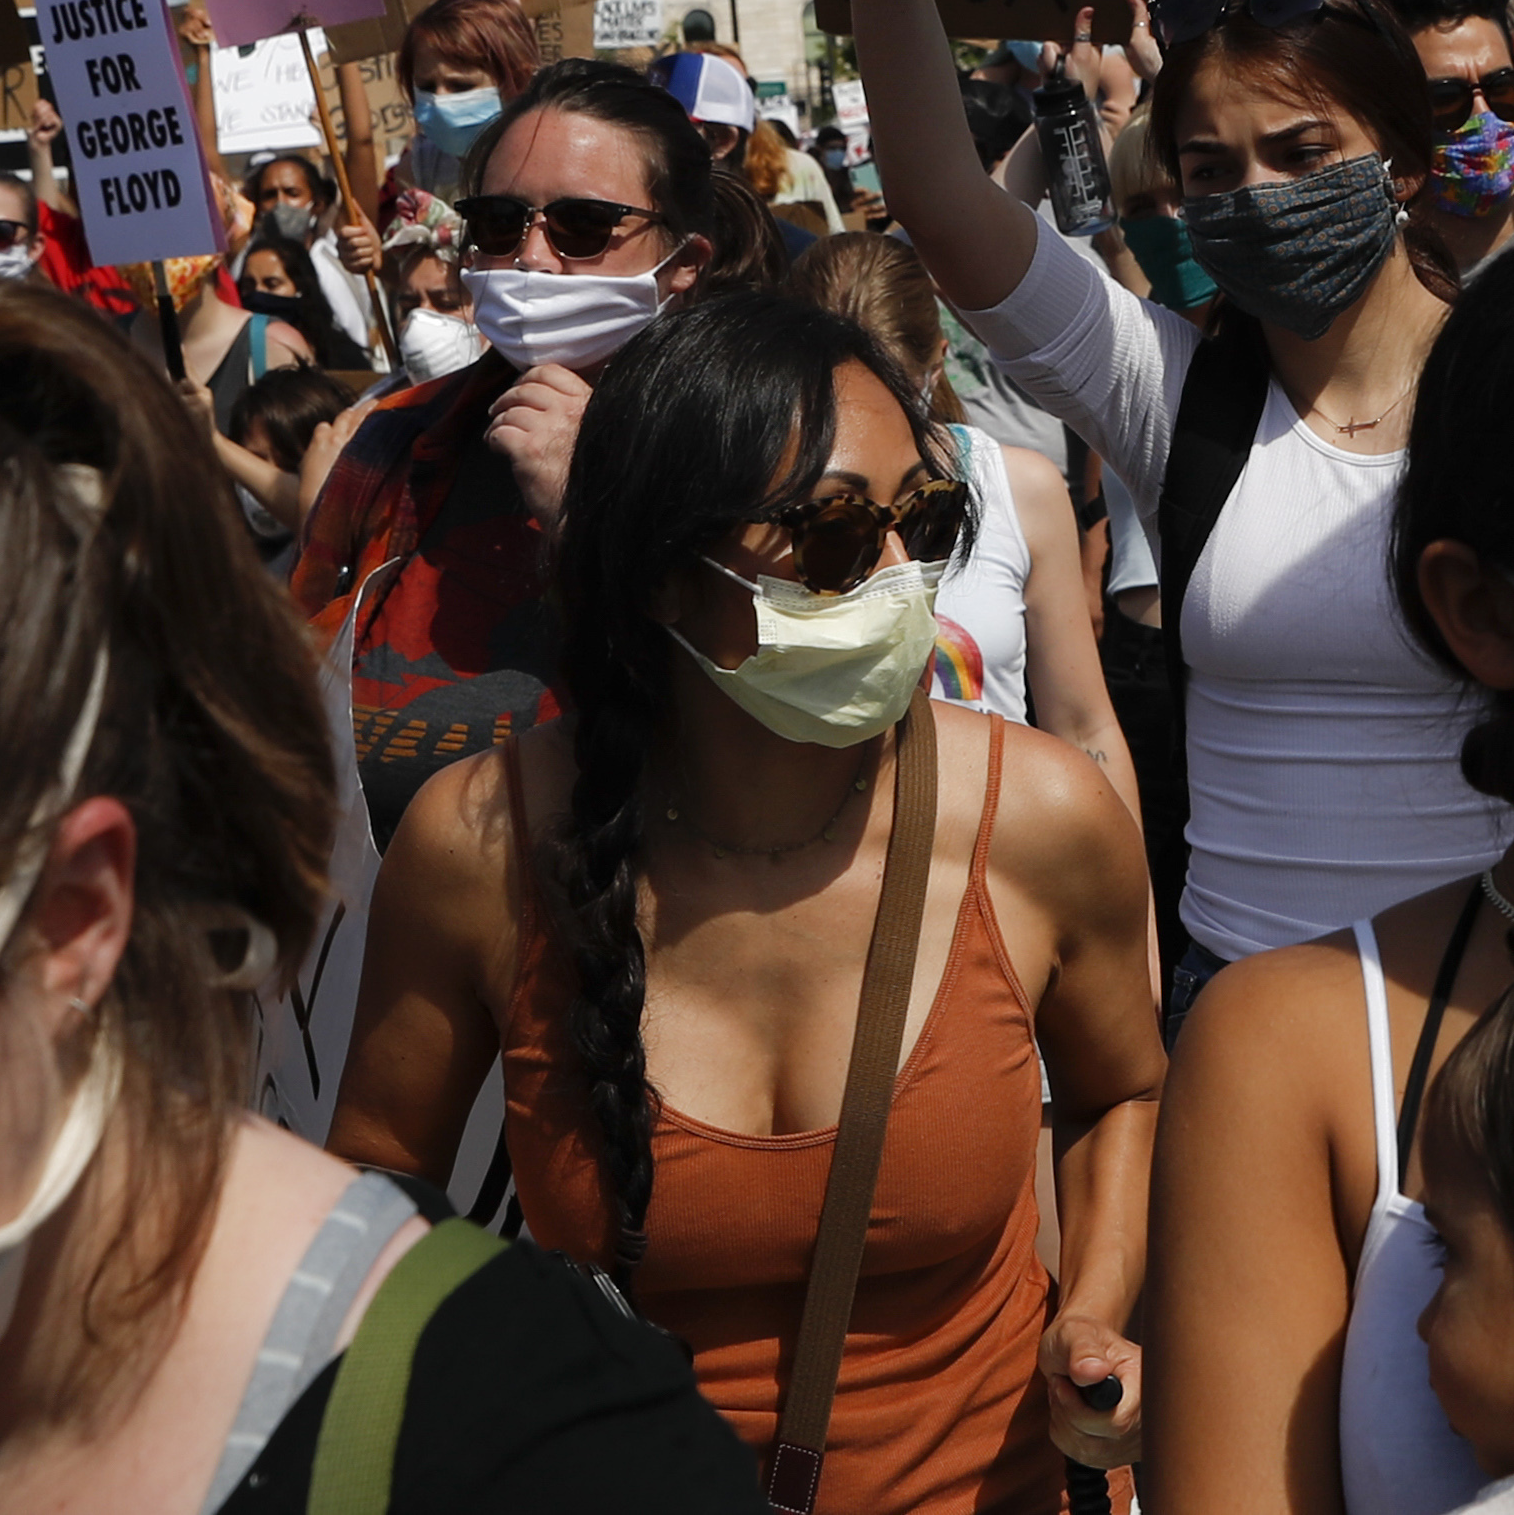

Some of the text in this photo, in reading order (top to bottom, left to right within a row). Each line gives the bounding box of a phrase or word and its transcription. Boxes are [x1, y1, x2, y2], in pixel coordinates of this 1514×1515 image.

[86, 53, 141, 97] FOR
[77, 106, 184, 159] GEORGE
[100, 168, 182, 217] FLOYD
